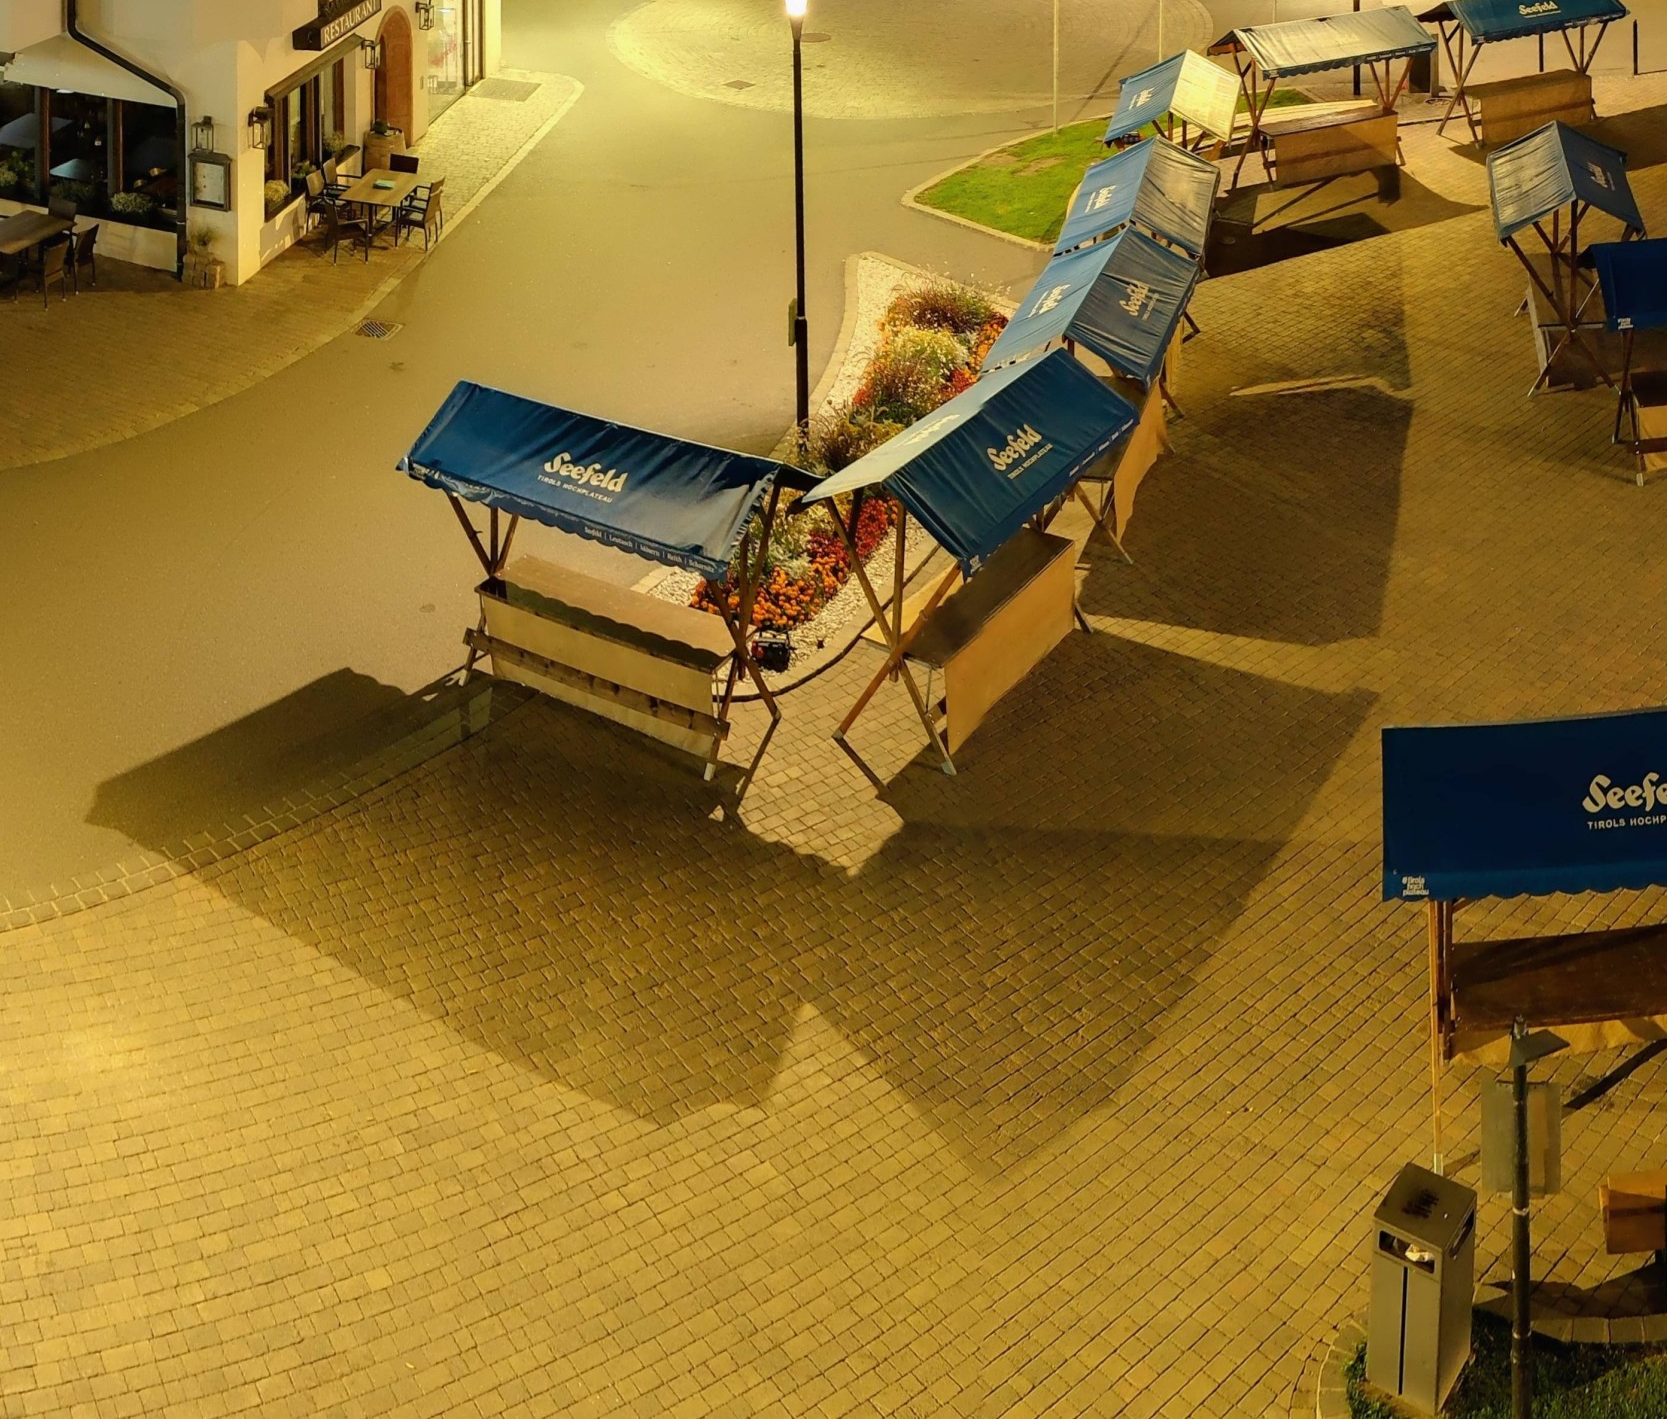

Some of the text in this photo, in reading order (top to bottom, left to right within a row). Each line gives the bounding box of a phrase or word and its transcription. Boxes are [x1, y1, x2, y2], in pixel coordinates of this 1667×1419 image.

[1518, 0, 1559, 15] Seefeld
[987, 424, 1042, 471] Seefeld
[544, 452, 628, 493] Seefeld
[537, 474, 613, 504] TIROLS HOCHPLATEAU
[1587, 818, 1626, 830] TIROLS
